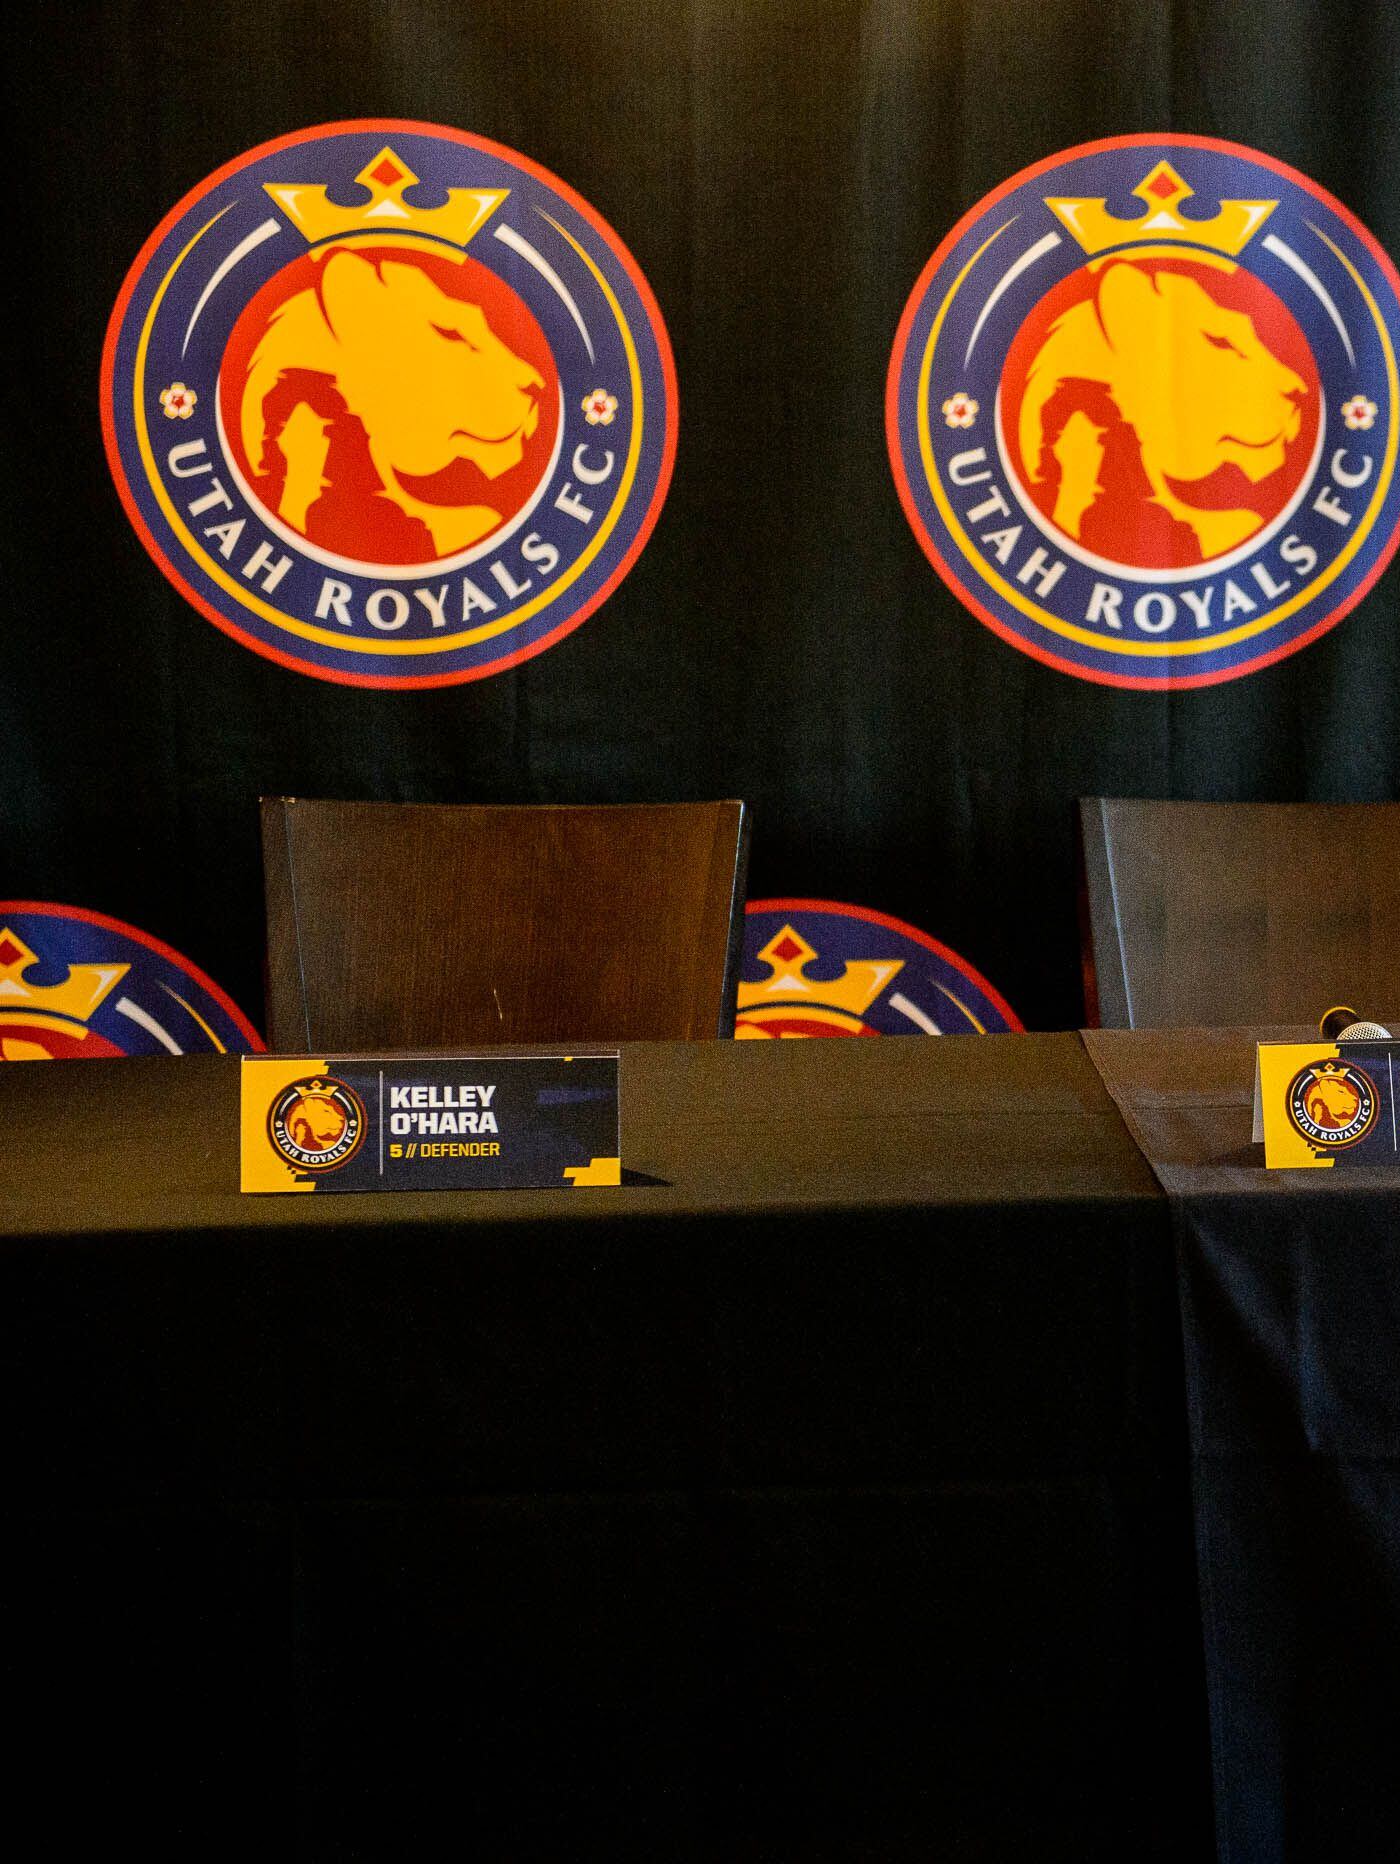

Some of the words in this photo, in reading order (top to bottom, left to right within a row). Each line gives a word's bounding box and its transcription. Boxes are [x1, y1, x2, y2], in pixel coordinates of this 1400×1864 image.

[166, 438, 294, 596] UTAH
[313, 531, 560, 631] ROYALS
[554, 443, 615, 525] FC
[948, 447, 1068, 598] UTAH
[1085, 534, 1318, 634] ROYALS
[1313, 448, 1374, 528] FC
[390, 1085, 496, 1109] KELLEY
[390, 1111, 499, 1135] O'HARA
[1295, 1111, 1317, 1136] UTAH
[1320, 1122, 1362, 1140] ROYALS
[1359, 1107, 1371, 1124] FC
[277, 1130, 299, 1158] UTAH
[300, 1144, 346, 1164] ROYALS
[346, 1129, 357, 1145] FC
[390, 1143, 403, 1158] 5
[420, 1142, 500, 1158] DEFENDER
